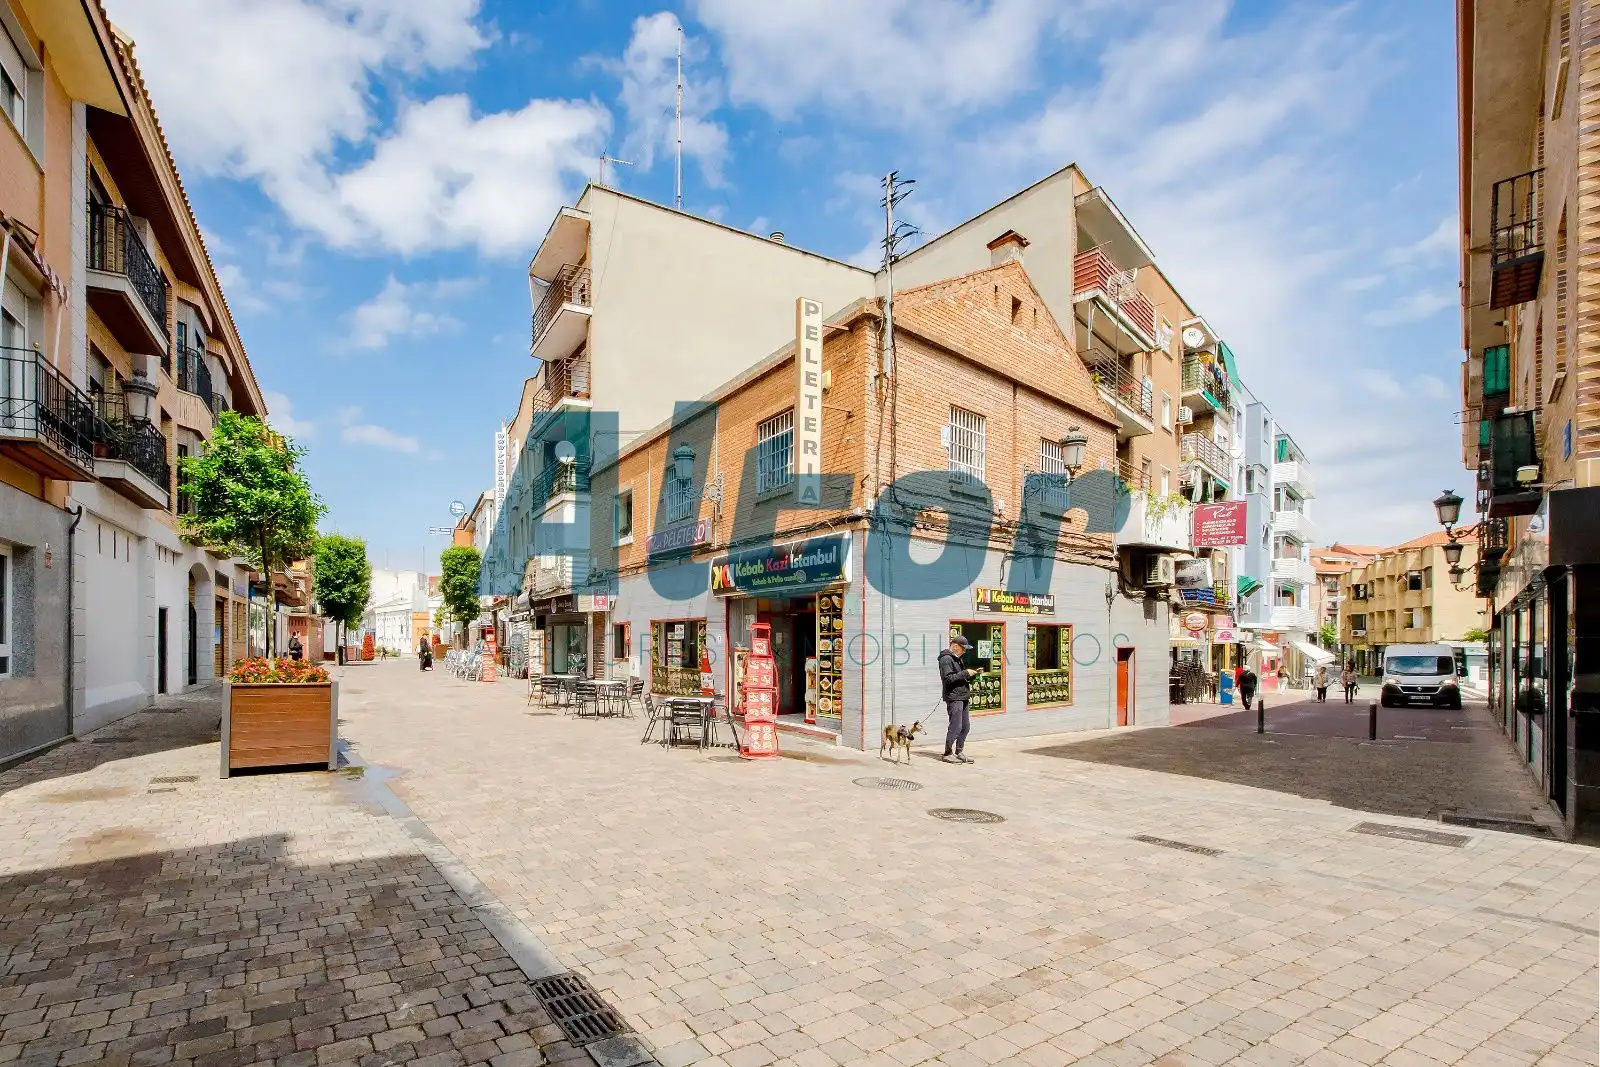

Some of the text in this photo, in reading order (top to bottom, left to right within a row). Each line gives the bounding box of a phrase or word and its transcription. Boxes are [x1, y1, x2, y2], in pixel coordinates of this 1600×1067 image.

[802, 301, 820, 500] PELETERIA
[735, 559, 764, 577] Kebab
[766, 554, 789, 572] Kazi
[790, 545, 837, 569] Istanbul
[992, 590, 1014, 603] Kebab
[1030, 593, 1054, 606] Istanbul
